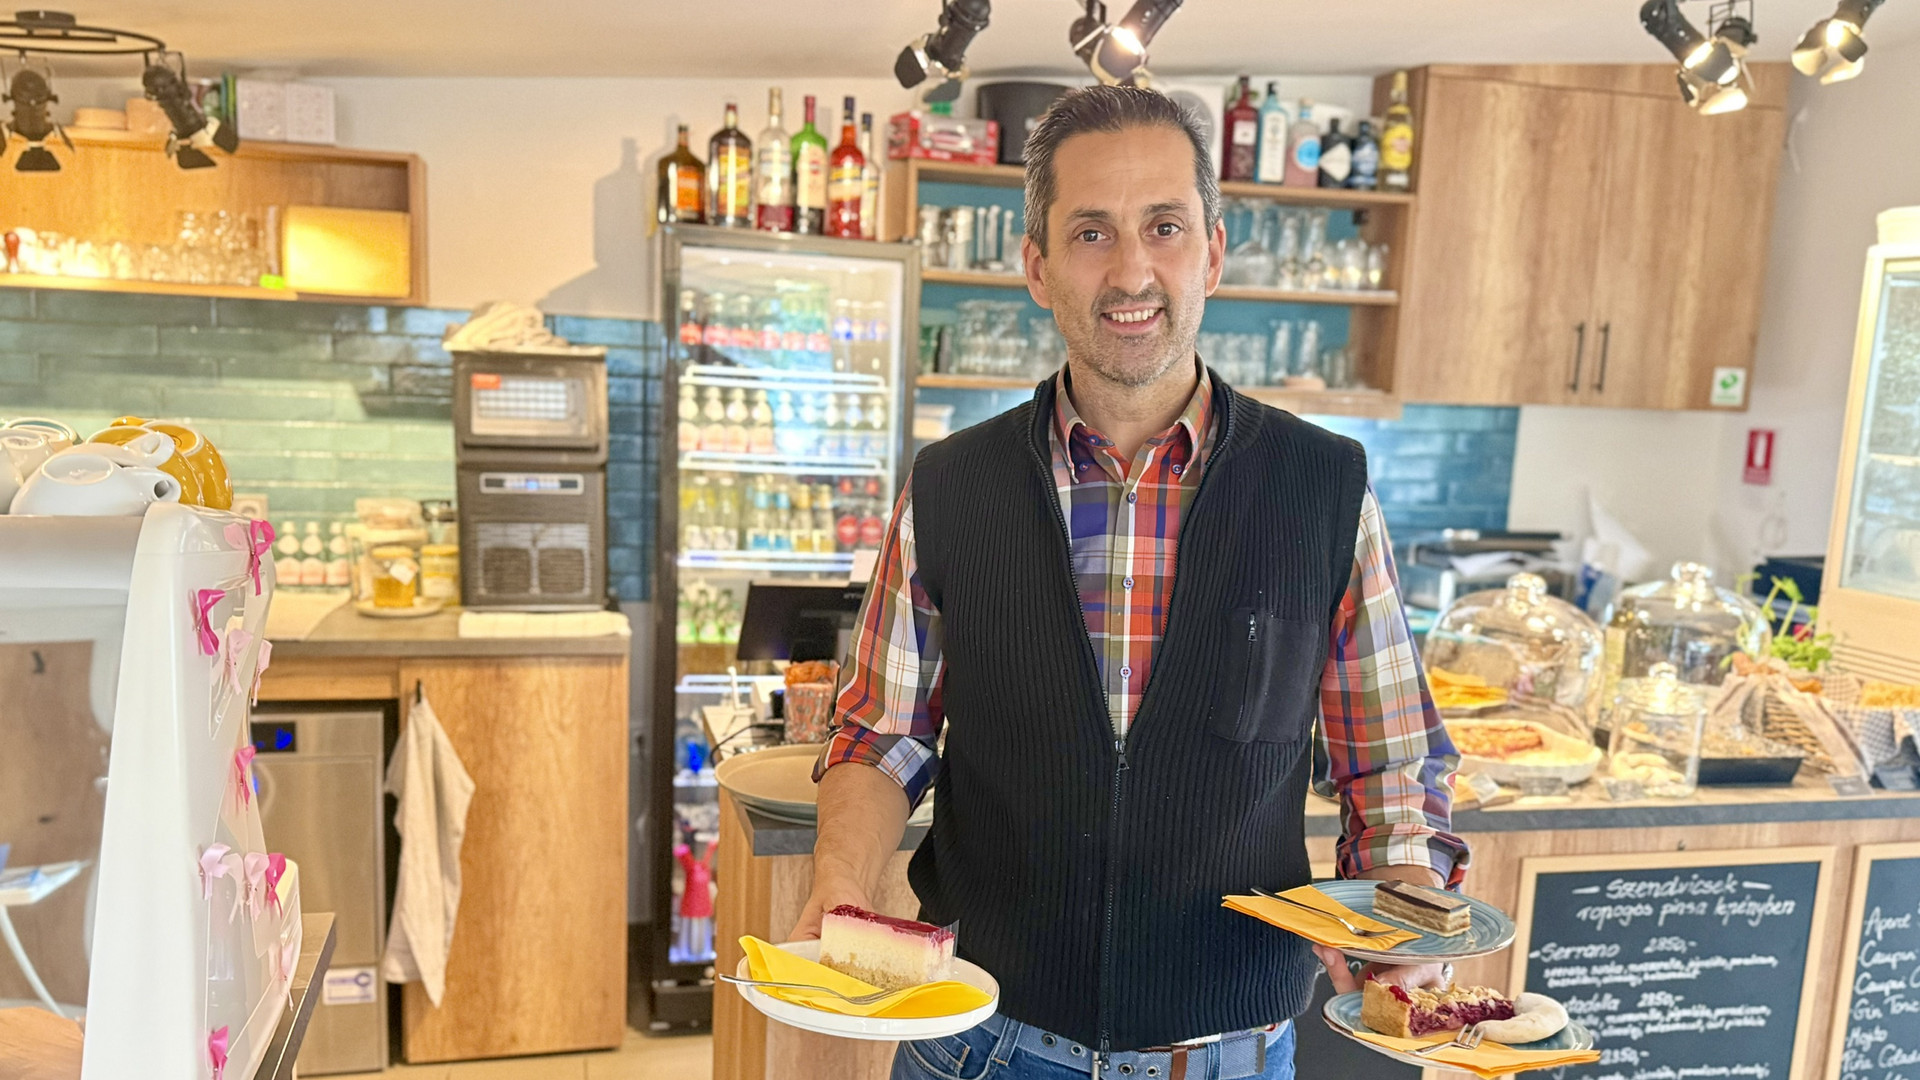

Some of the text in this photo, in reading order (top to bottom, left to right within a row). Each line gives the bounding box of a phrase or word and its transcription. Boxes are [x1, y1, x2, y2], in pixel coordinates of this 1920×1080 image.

[1606, 873, 1738, 899] Szendvicsek
[1853, 997, 1883, 1020] Gin
[1878, 1043, 1920, 1068] Colad
